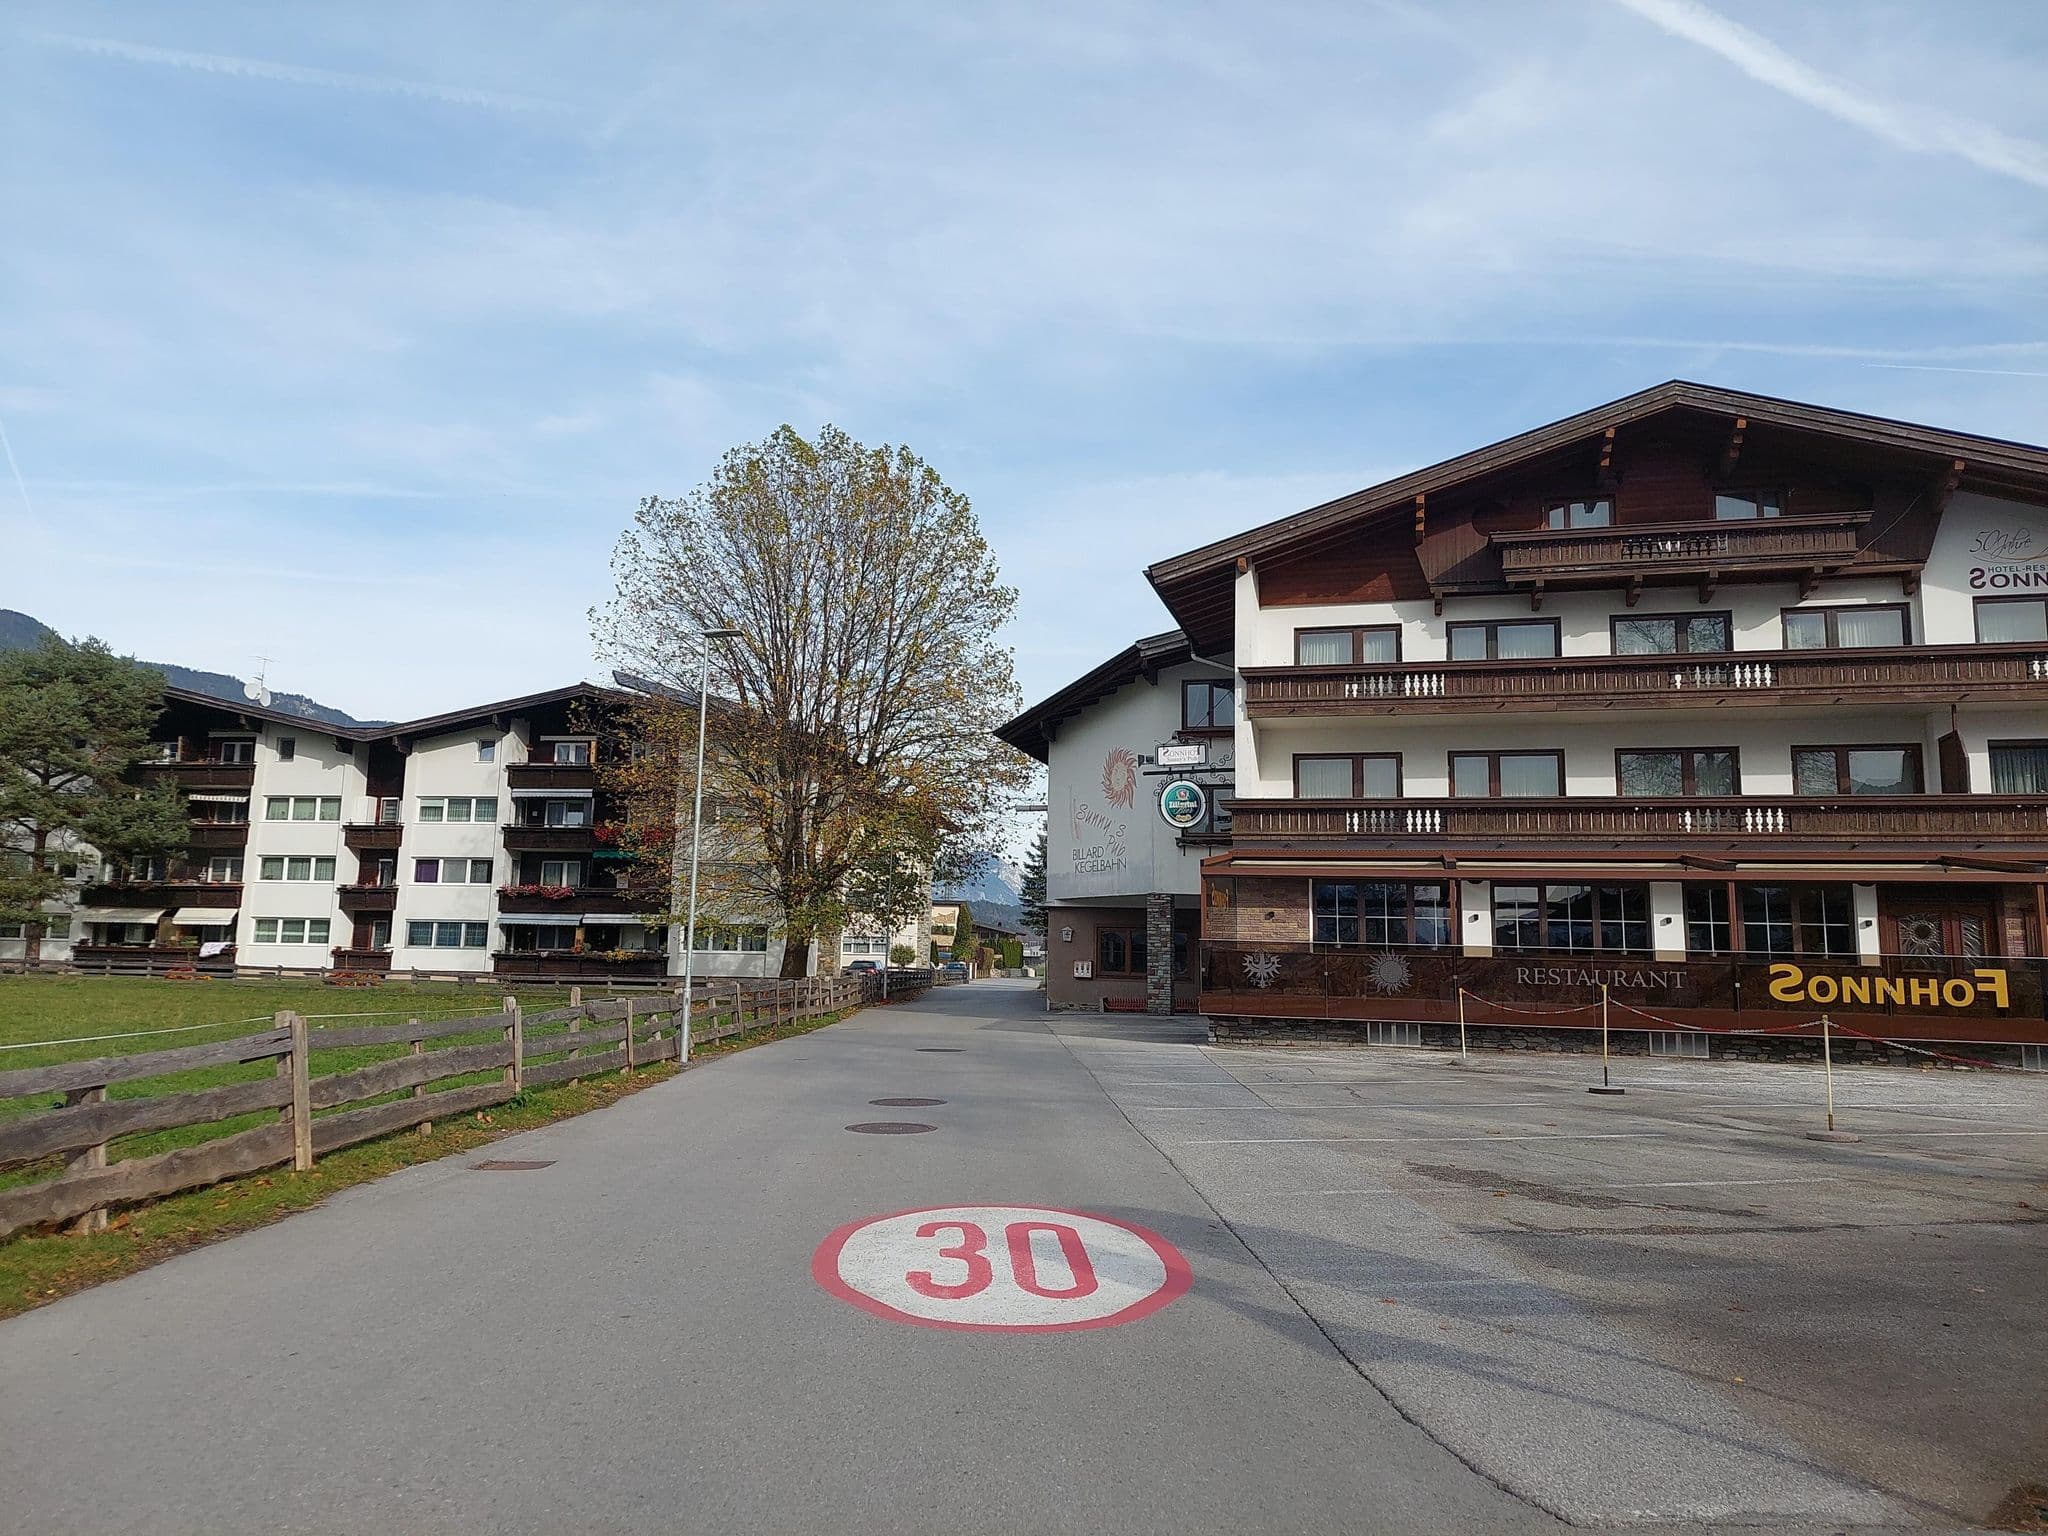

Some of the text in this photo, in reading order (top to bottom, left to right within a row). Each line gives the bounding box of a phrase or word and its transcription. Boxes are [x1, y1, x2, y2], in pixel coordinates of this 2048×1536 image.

[1073, 846, 1105, 861] BILLARD
[1074, 858, 1127, 875] KEGELBAHN
[1516, 967, 1687, 989] RESTAURANT
[905, 1221, 1099, 1300] 30
